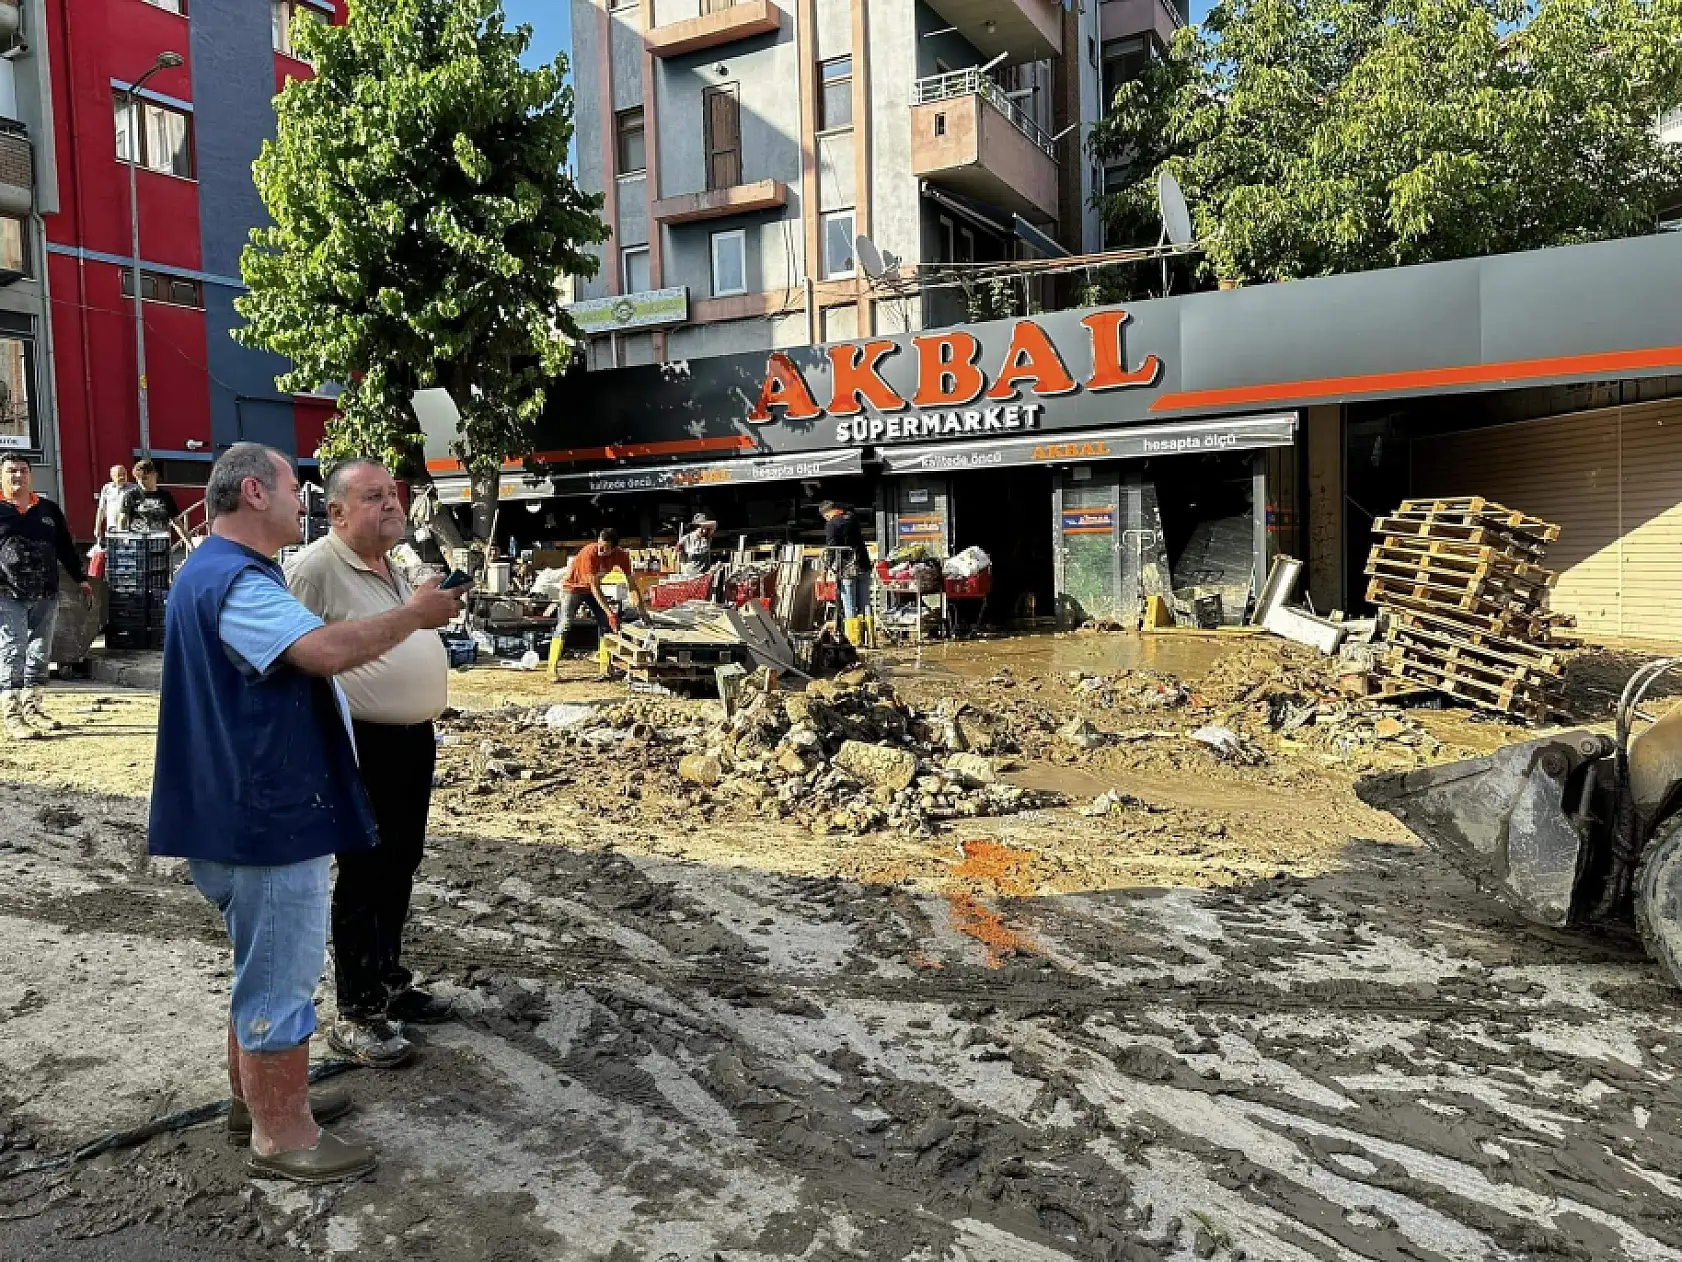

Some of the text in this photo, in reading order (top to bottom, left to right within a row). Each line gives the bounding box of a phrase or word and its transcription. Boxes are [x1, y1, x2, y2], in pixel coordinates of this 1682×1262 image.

[748, 310, 1161, 423] AKBAL
[836, 404, 1040, 442] SÜPERMARKET
[1031, 440, 1111, 460] AKBAL
[1143, 436, 1200, 451] hesapta
[1204, 432, 1235, 448] ölçü
